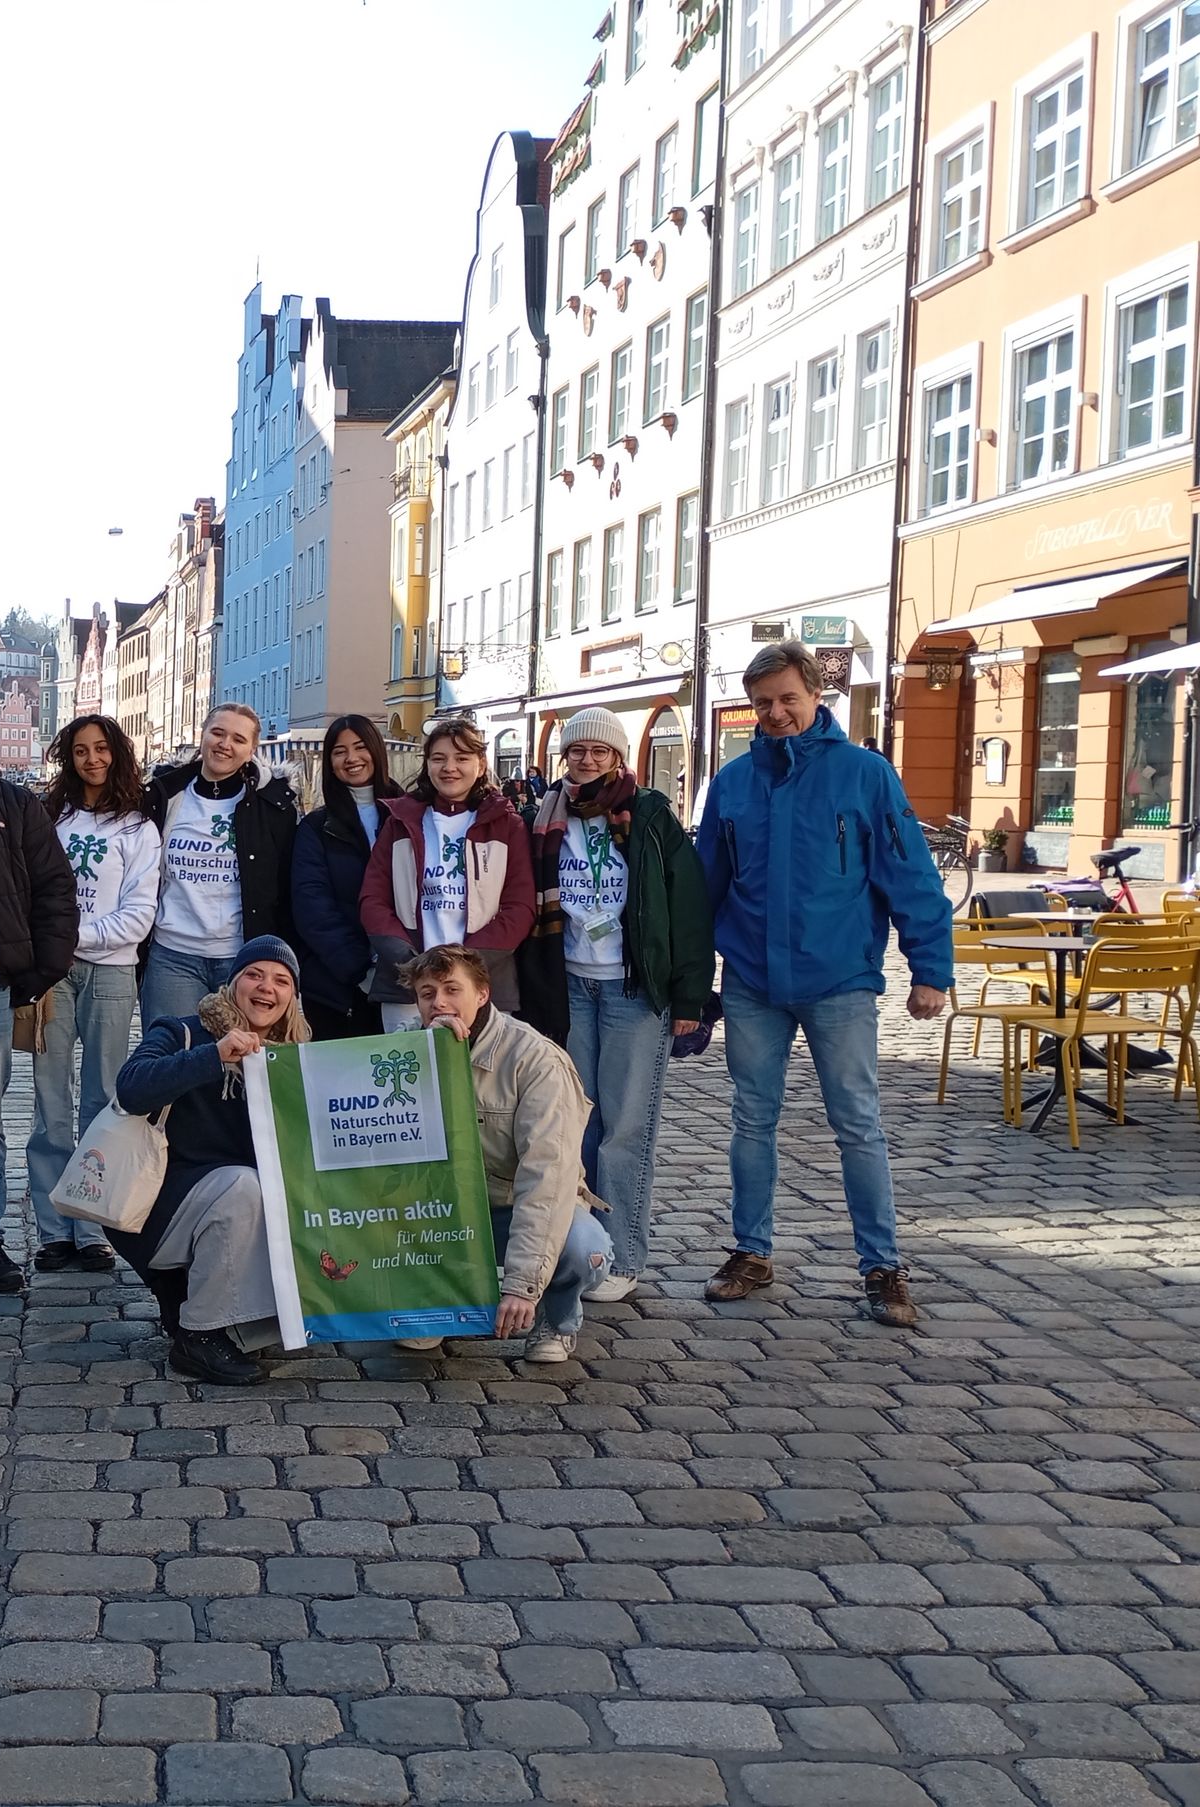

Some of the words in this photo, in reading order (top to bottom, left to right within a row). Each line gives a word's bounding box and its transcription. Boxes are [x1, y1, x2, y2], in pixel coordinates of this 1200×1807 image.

[721, 709, 759, 722] GOLDANKA
[168, 838, 213, 852] BUND
[168, 854, 239, 869] Naturschut
[559, 858, 589, 871] UND
[179, 869, 219, 884] Bayern
[424, 866, 445, 879] ND
[602, 891, 623, 904] e.V.
[328, 1094, 380, 1113] BUND
[330, 1111, 419, 1130] Naturschutz
[333, 1134, 346, 1148] in
[349, 1131, 397, 1149] Bayern
[400, 1127, 423, 1142] e.V.
[304, 1209, 323, 1228] In
[328, 1207, 398, 1230] Bayern
[404, 1199, 453, 1221] aktiv
[397, 1230, 416, 1248] für
[420, 1226, 475, 1244] Mensch
[372, 1253, 400, 1269] und
[404, 1251, 443, 1266] Natur
